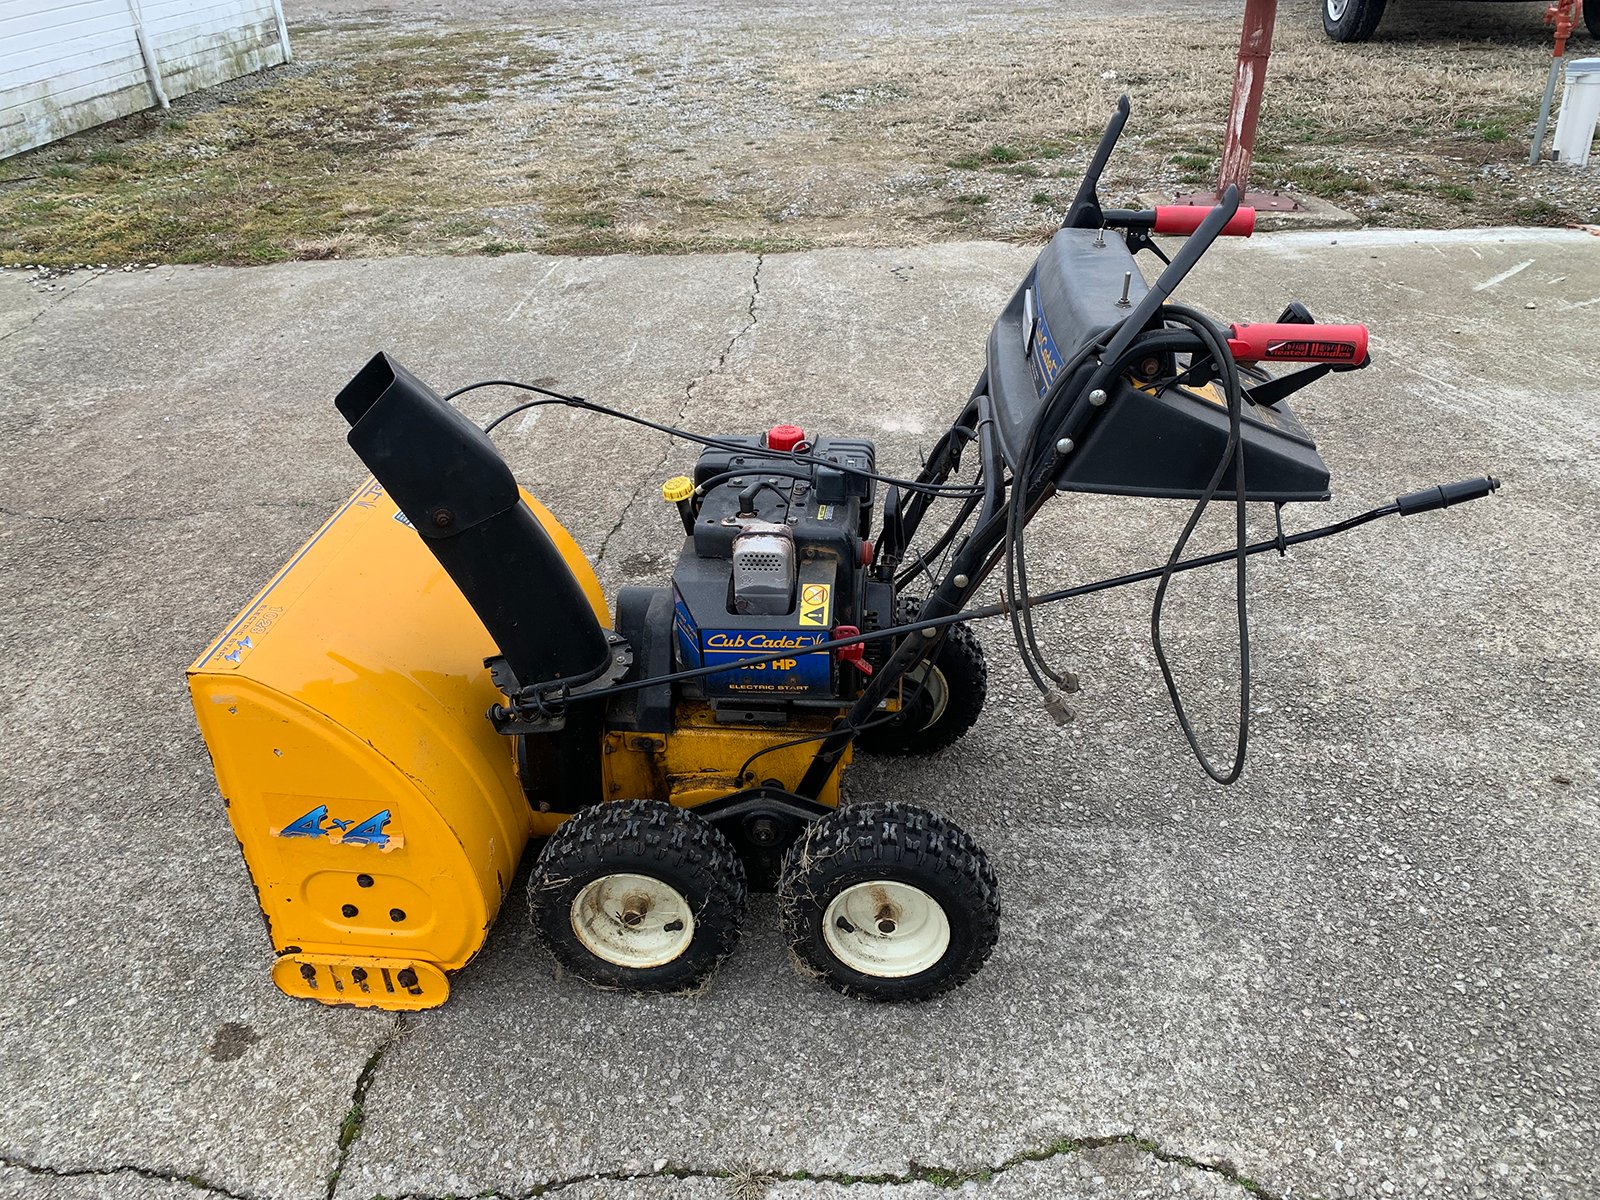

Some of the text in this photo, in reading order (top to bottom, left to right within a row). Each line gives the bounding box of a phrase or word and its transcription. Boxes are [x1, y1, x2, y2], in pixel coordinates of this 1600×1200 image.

[1310, 343, 1351, 357] Handles
[250, 606, 284, 635] 1028
[213, 604, 268, 662] ELECTRIC START
[707, 633, 812, 649] Cub Cadet
[772, 658, 797, 670] HP
